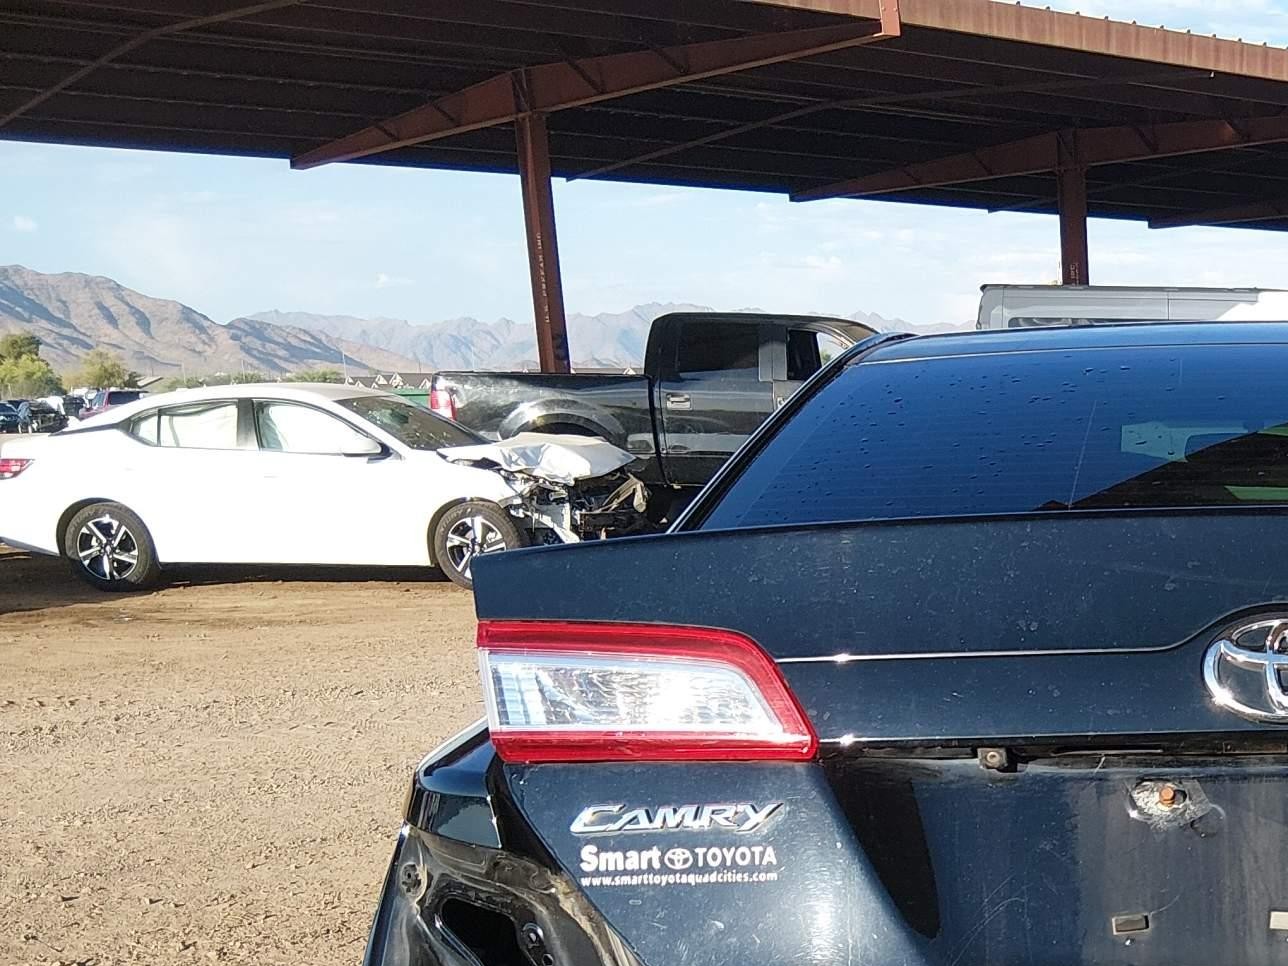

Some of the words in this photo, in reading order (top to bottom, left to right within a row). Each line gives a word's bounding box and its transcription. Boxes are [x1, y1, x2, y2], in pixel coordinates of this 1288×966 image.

[570, 802, 784, 835] CAMRY
[580, 844, 661, 872] Smart
[694, 845, 778, 867] TOYOTA
[580, 869, 778, 887] www.smarttoyotaquadcities.com
